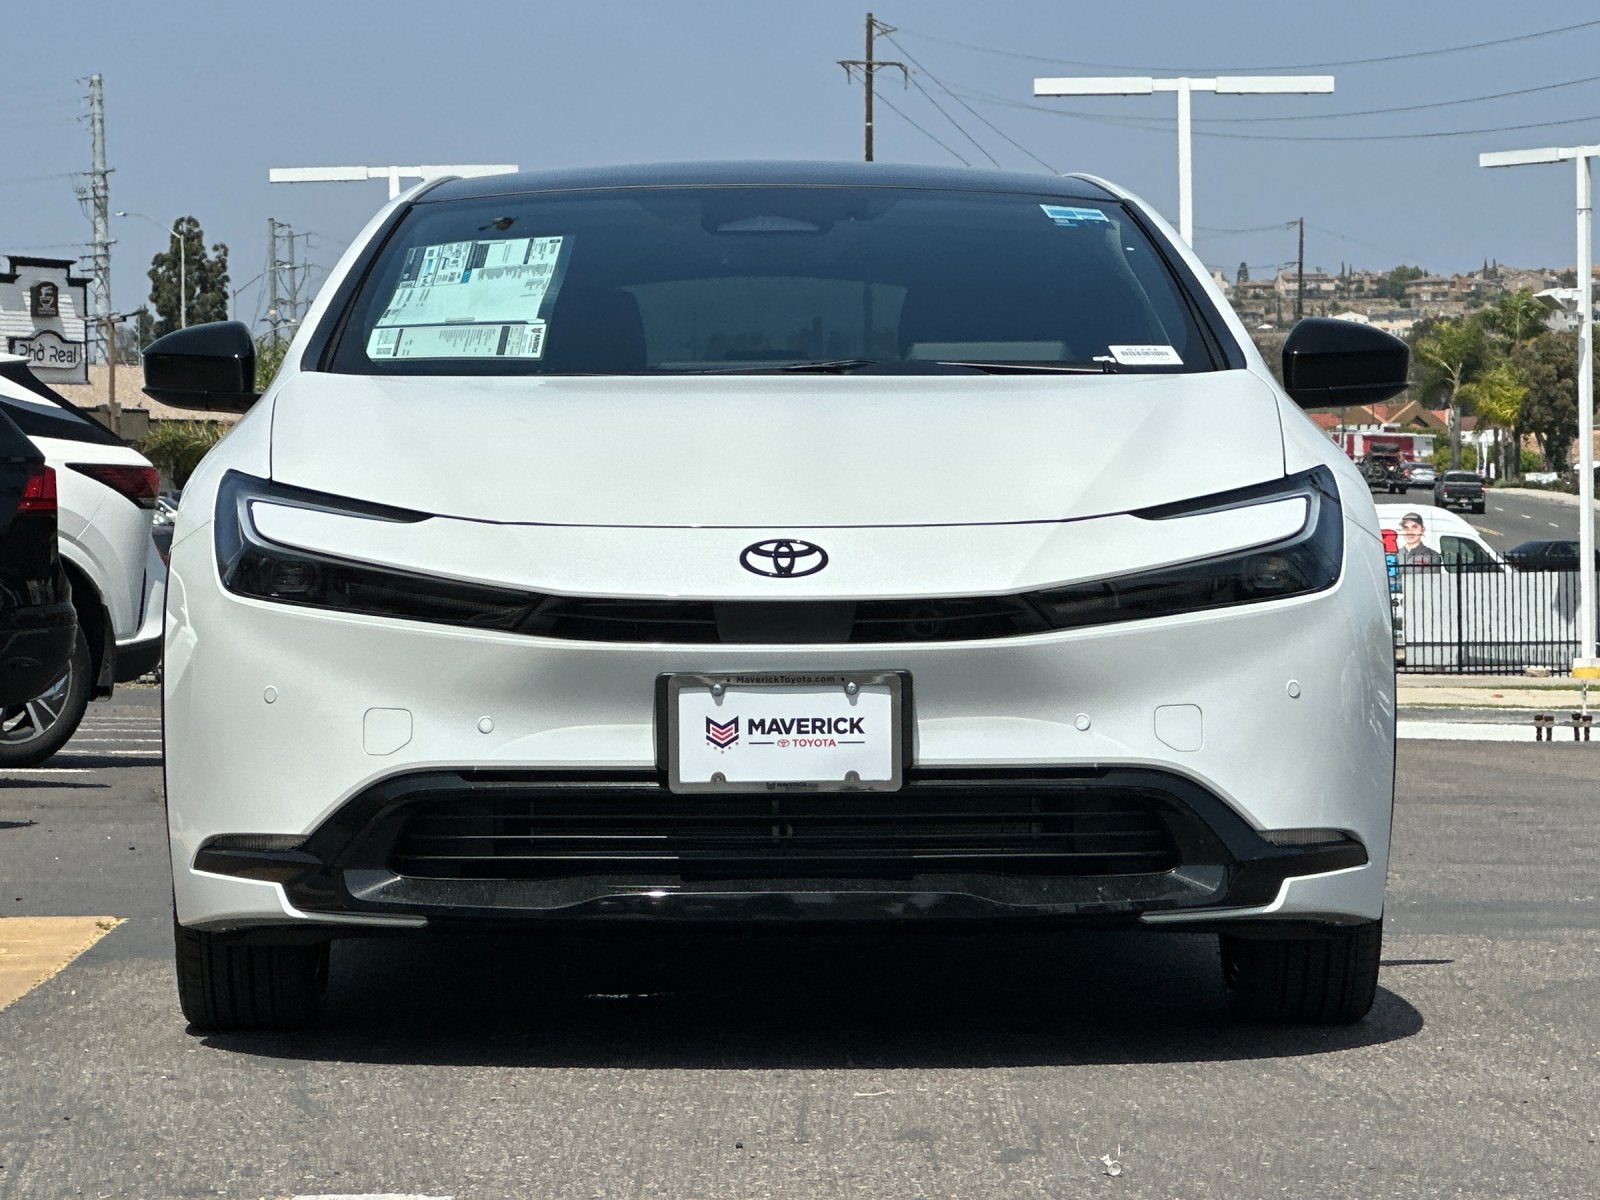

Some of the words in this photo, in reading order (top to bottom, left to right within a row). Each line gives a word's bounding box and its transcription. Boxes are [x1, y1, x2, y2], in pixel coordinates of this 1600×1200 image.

[49, 345, 77, 363] Real
[736, 675, 835, 685] MaverickToyota.com
[747, 717, 865, 735] MAVERICK
[792, 738, 837, 748] TOYOTA
